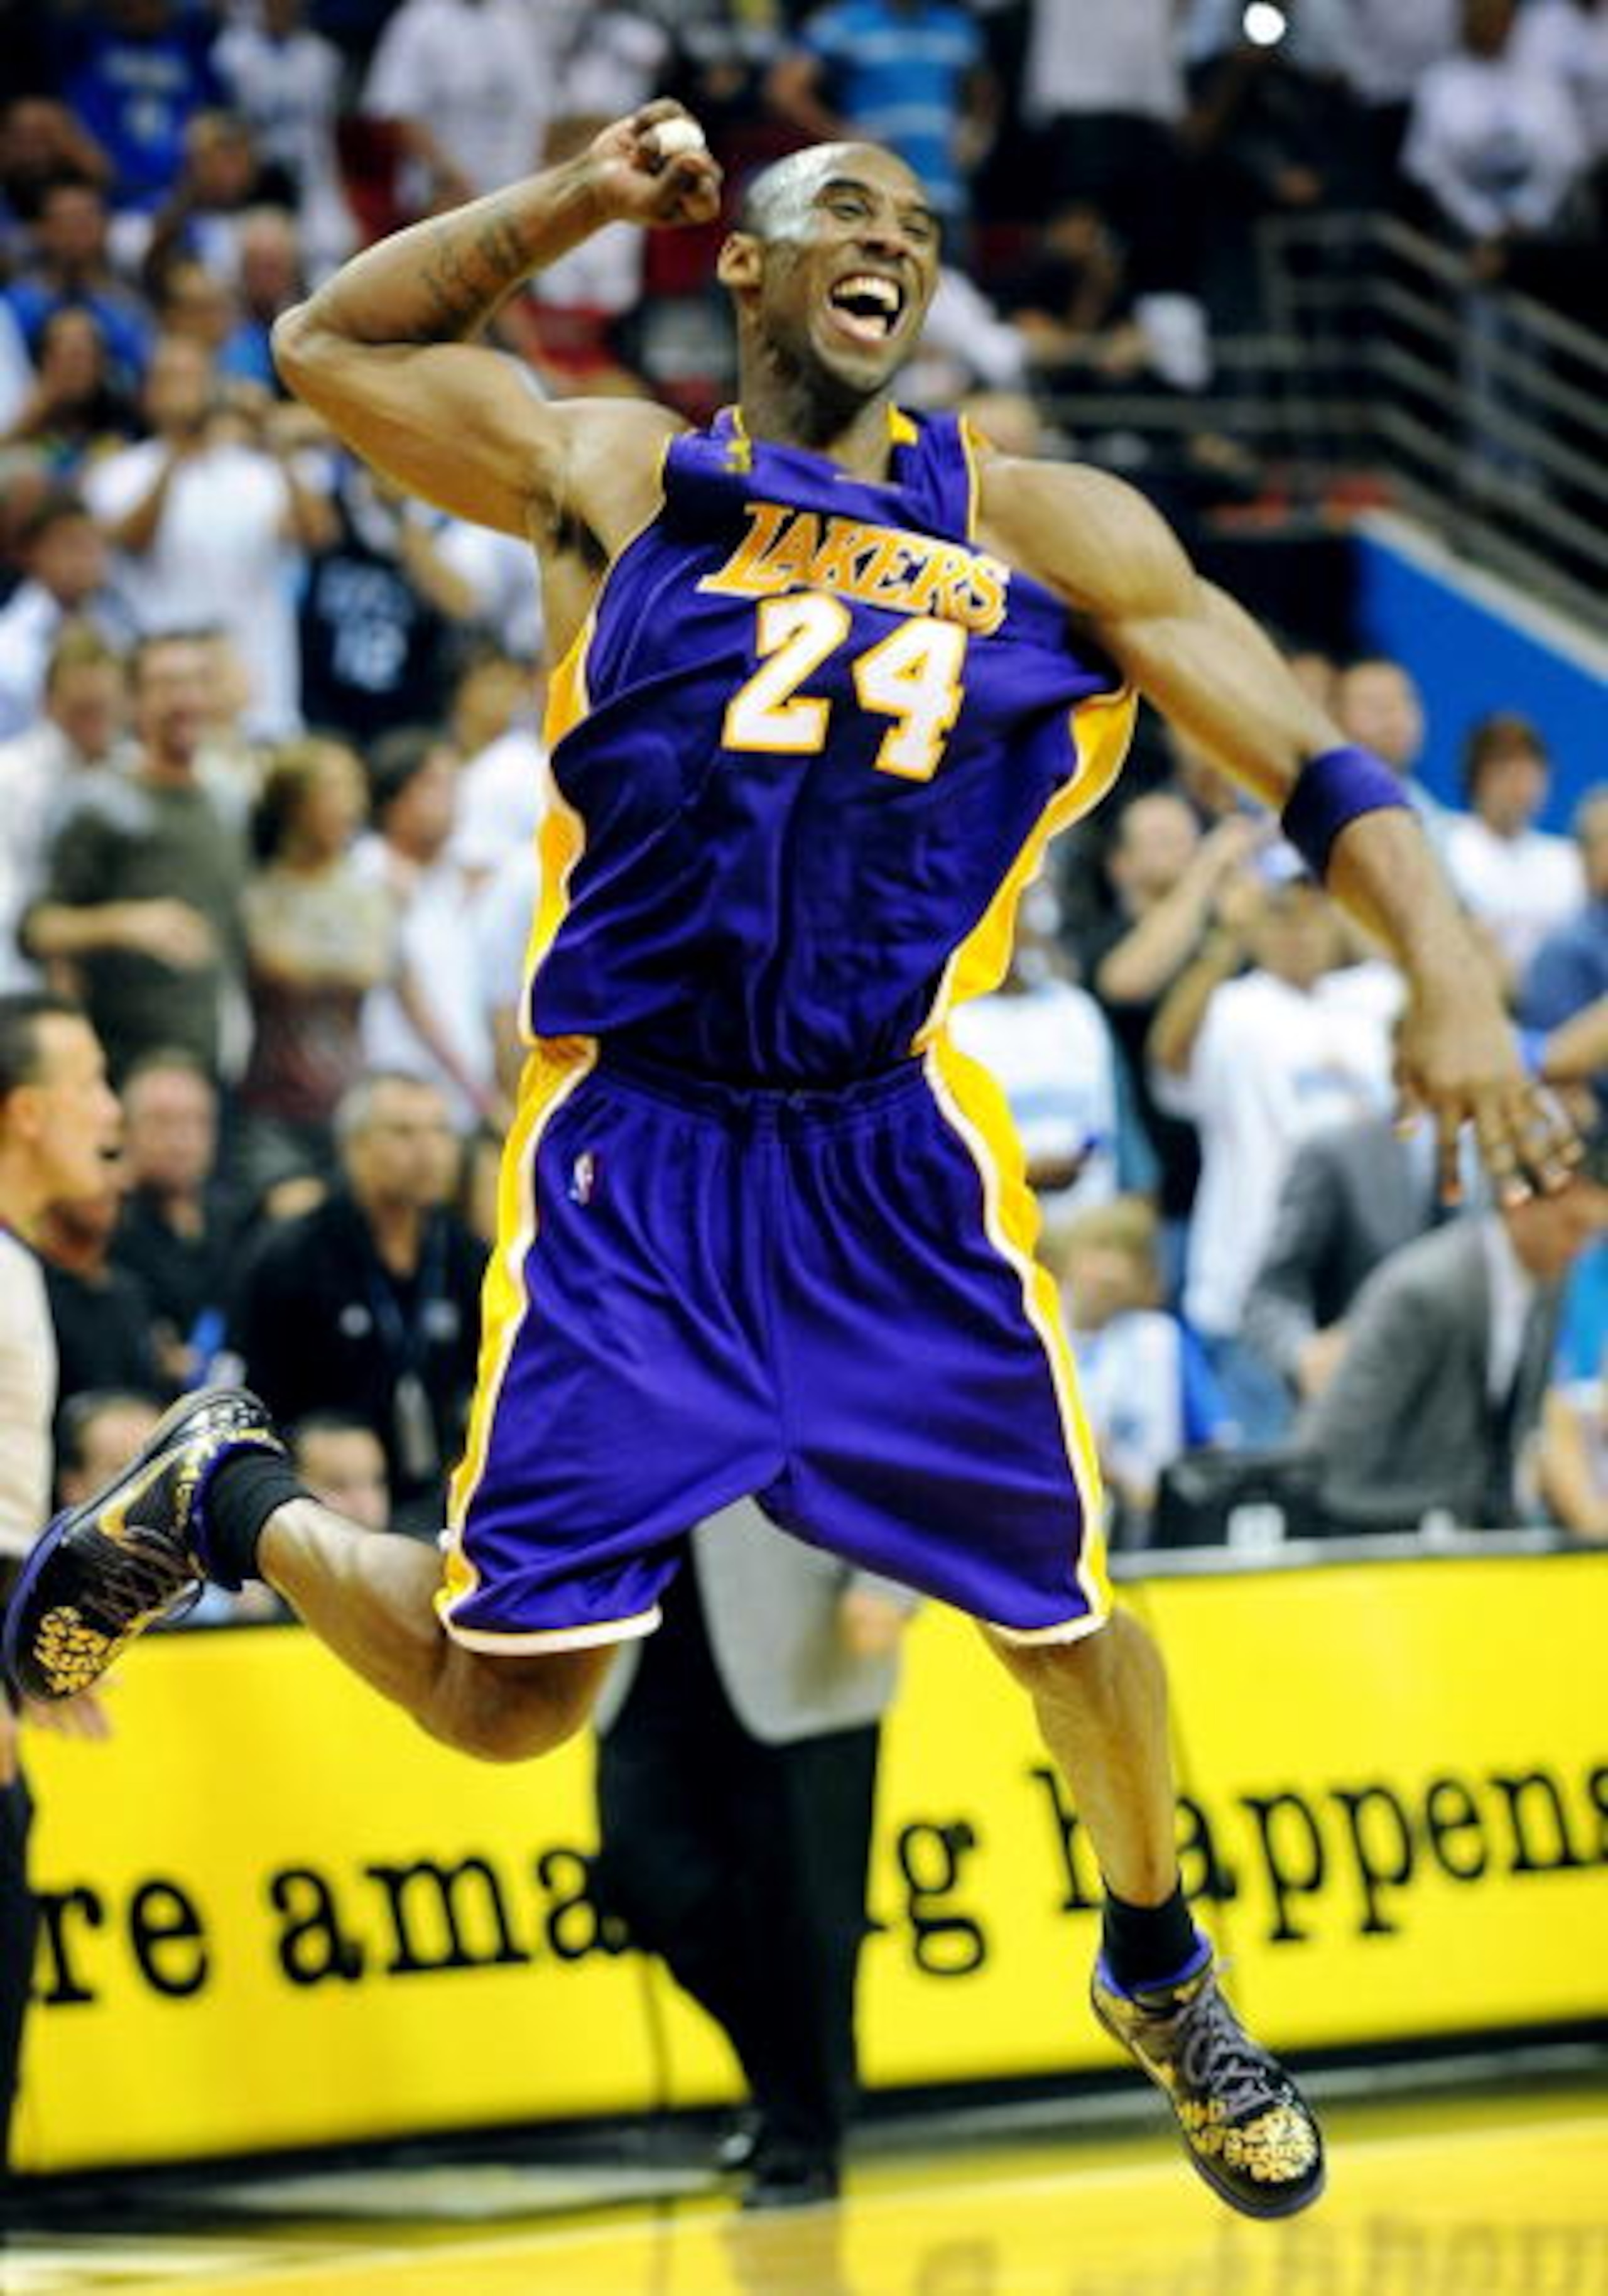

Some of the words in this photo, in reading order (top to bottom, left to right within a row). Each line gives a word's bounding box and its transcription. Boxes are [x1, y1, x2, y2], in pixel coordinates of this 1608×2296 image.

[695, 503, 1009, 636] LAKERS
[721, 590, 967, 783] 24
[31, 1878, 209, 2006] re
